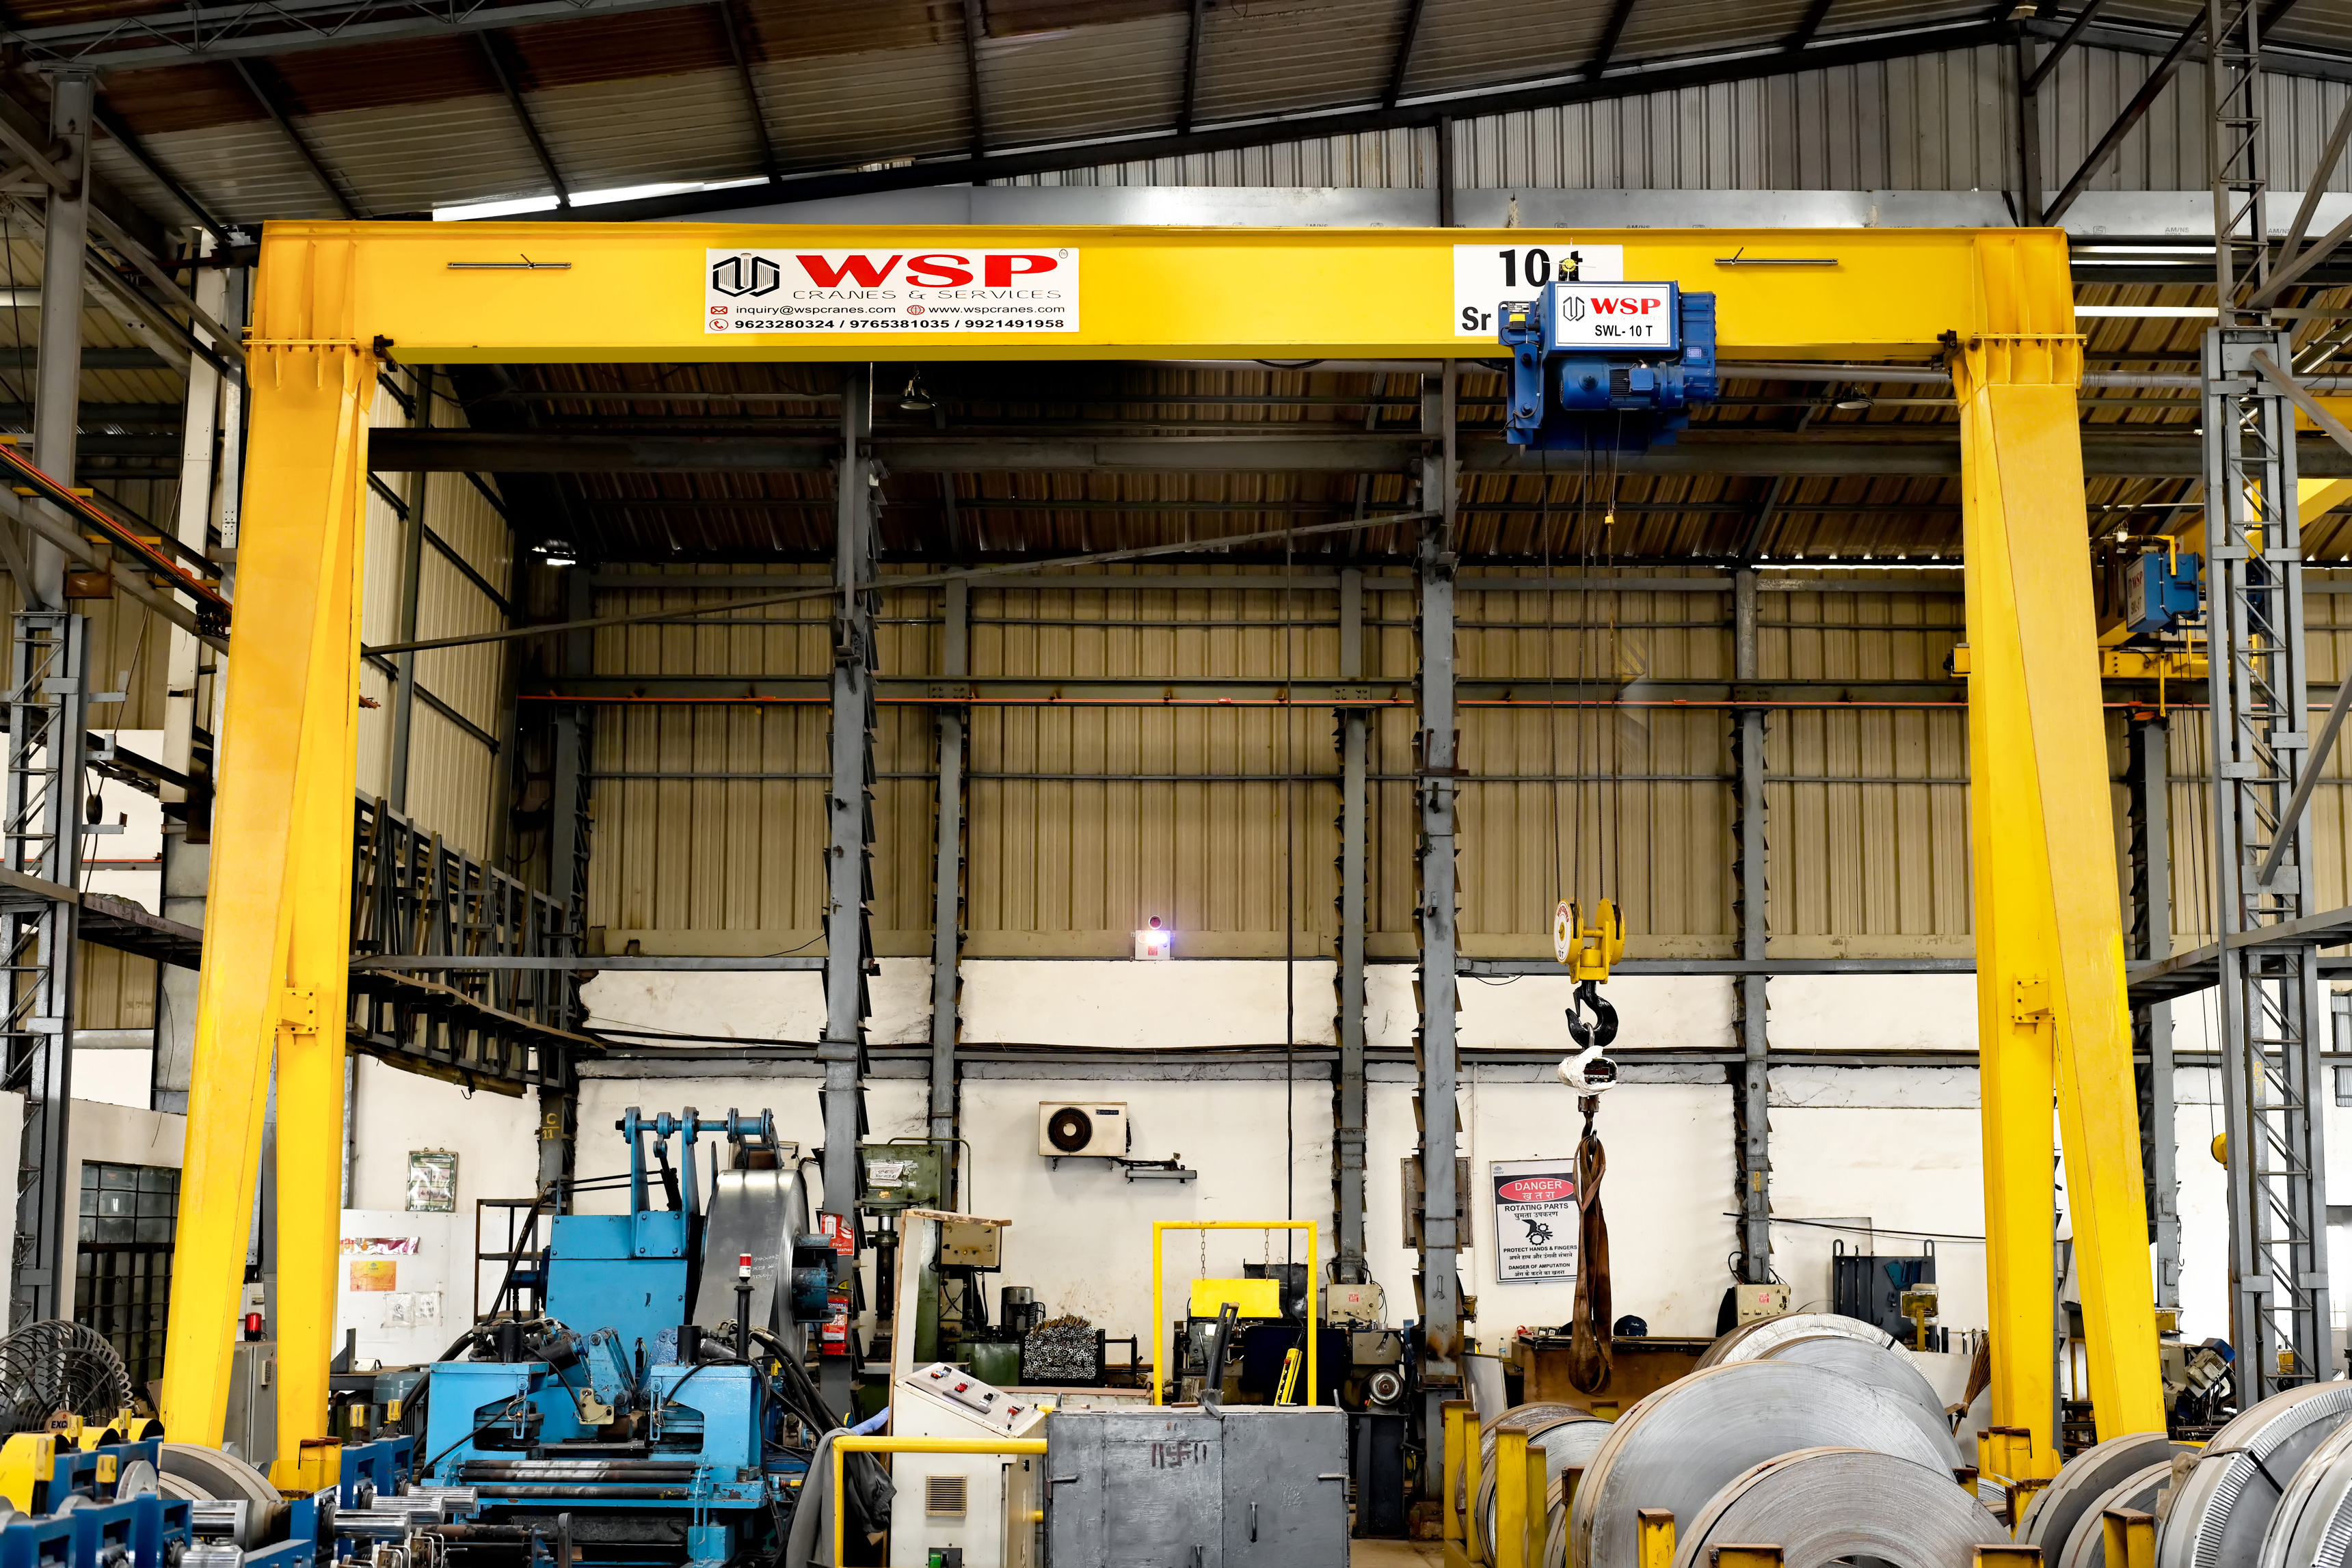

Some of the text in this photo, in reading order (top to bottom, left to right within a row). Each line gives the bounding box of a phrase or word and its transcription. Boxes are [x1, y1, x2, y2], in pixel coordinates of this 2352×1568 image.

[795, 254, 1058, 288] WSP
[793, 290, 1061, 299] CRANES & SERVICES
[736, 306, 896, 315] inquiry@wspcranes.com
[928, 306, 1065, 314] www.wspcranes.com
[1590, 297, 1661, 315] WSP
[735, 319, 1064, 329] 9623280324 / 9765381035 / 9921491958
[1462, 306, 1491, 331] Sr
[1594, 325, 1653, 336] SWL- 10 T
[2132, 571, 2143, 590] WSP
[1515, 1180, 1562, 1191] DANGER
[51, 1420, 68, 1429] EXC
